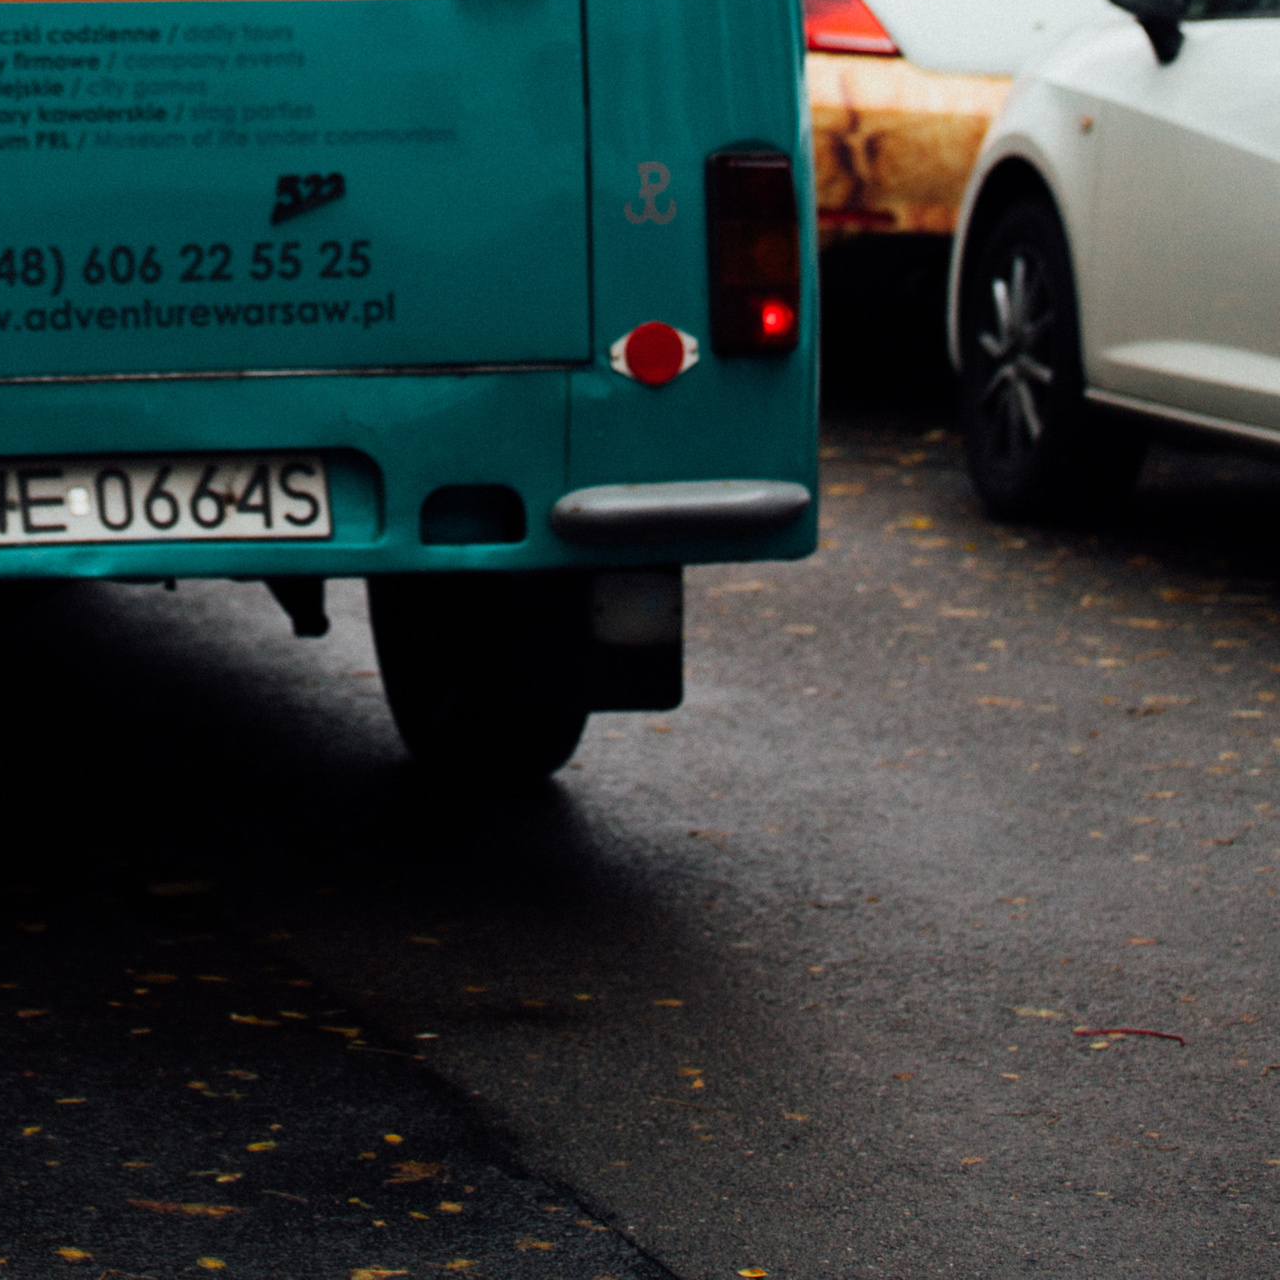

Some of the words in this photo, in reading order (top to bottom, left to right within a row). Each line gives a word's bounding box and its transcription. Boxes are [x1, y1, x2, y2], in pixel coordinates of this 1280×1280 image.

[46, 23, 161, 45] codzienne
[82, 243, 163, 286] 606
[179, 242, 234, 283] 22
[248, 240, 302, 281] 55
[318, 239, 372, 280] 25
[93, 461, 321, 532] 0664S
